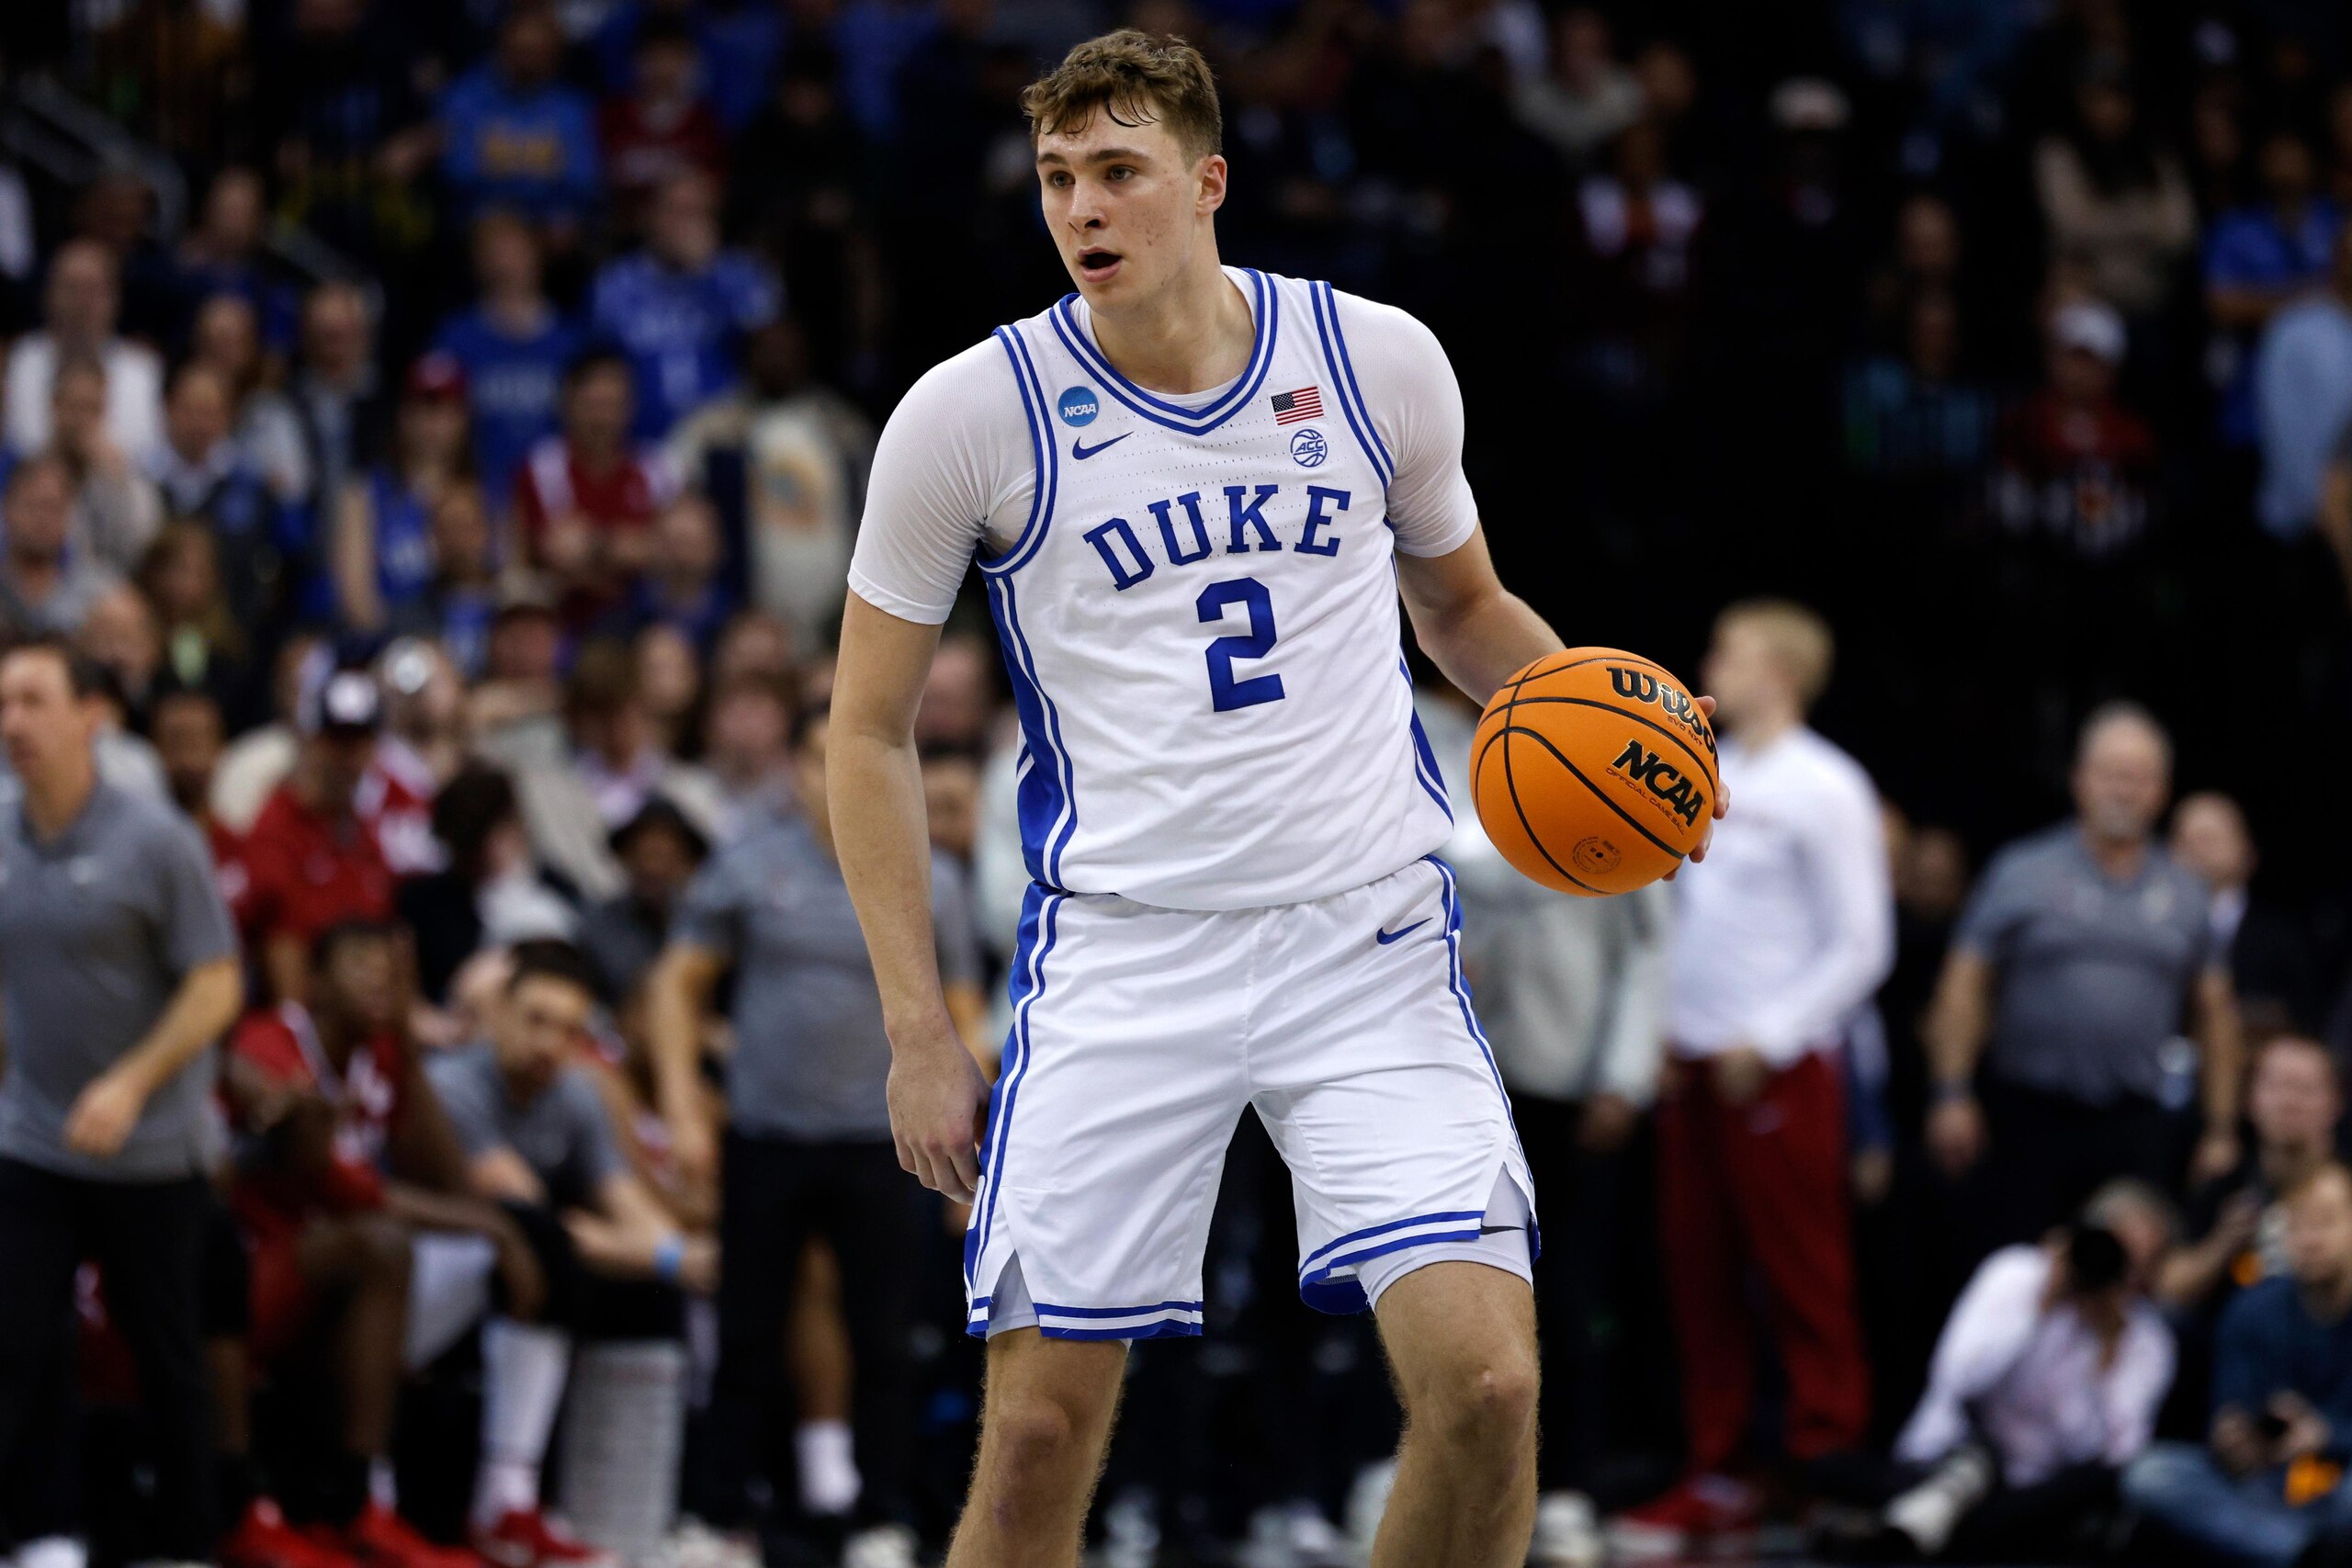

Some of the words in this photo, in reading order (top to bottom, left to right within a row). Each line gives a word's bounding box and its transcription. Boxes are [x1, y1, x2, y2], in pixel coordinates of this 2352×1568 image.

[1064, 403, 1097, 418] NCAA
[1294, 439, 1325, 453] ACC
[1082, 485, 1351, 592] DUKE
[1196, 577, 1286, 713] 2
[1667, 715, 1686, 732] EVO
[1688, 730, 1702, 747] NXT
[1606, 768, 1647, 799] OFFICIAL
[1649, 797, 1672, 819] GAME
[1671, 817, 1684, 836] BALL
[1611, 738, 1704, 828] NCAA
